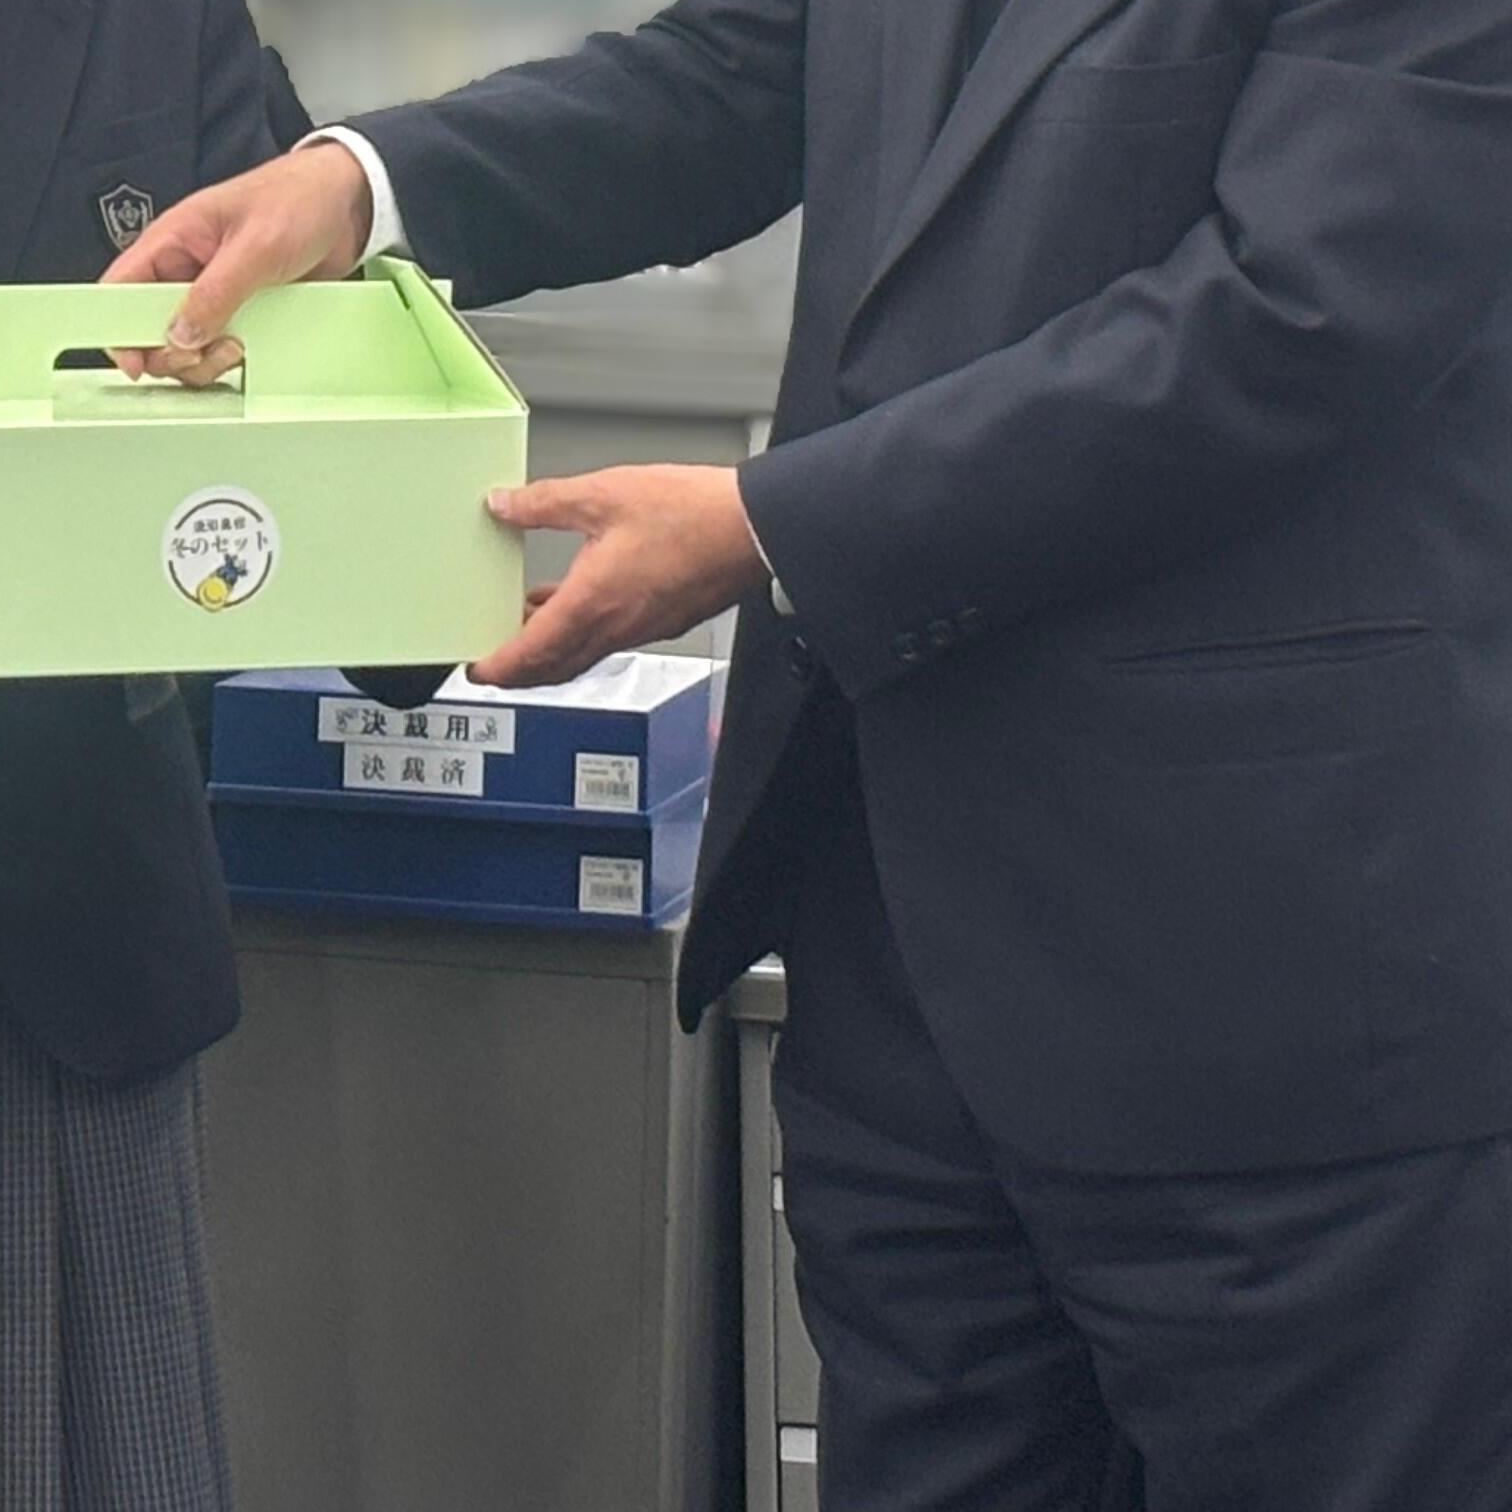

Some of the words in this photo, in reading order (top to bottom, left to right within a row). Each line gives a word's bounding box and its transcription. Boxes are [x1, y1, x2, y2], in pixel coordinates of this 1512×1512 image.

[361, 708, 469, 742] 決裁用
[361, 754, 466, 786] 決裁済
